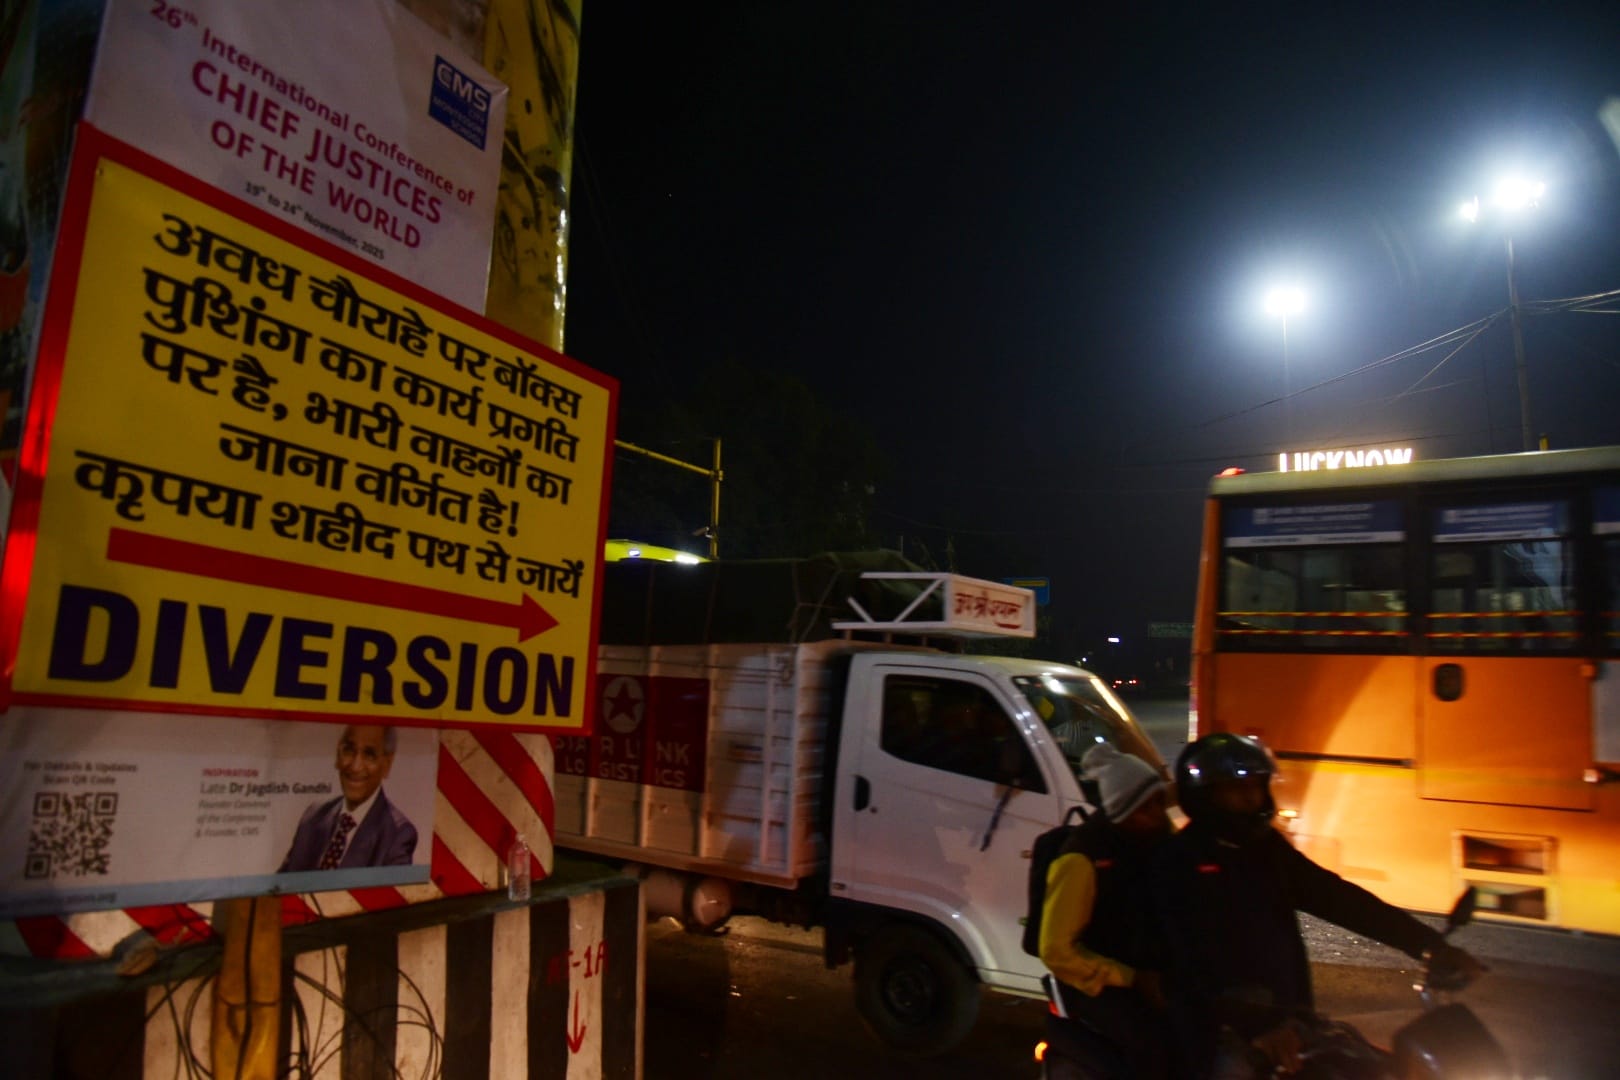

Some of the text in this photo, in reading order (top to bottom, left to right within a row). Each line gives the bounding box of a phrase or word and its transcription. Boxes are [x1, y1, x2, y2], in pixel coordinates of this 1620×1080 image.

[192, 60, 442, 224] CHIEF JUSTICES
[203, 27, 348, 132] International
[354, 122, 453, 194] Conference
[457, 189, 475, 206] of
[437, 63, 488, 113] CMS
[211, 120, 420, 248] OF THE WORLD
[143, 267, 579, 462] पुशिंग का कार्य प्रगति
[154, 213, 582, 419] अवध चौराहे पर बॉक्स
[141, 332, 572, 504] पर है, भारी वाहनों का
[219, 422, 348, 491] जाना
[355, 461, 472, 524] वर्जित
[75, 450, 584, 598] कृपया शहीद पथ से जायें
[48, 584, 575, 717] DIVERSION
[230, 782, 244, 794] Dr
[245, 782, 290, 797] Jagdish
[292, 782, 332, 794] Gandhi
